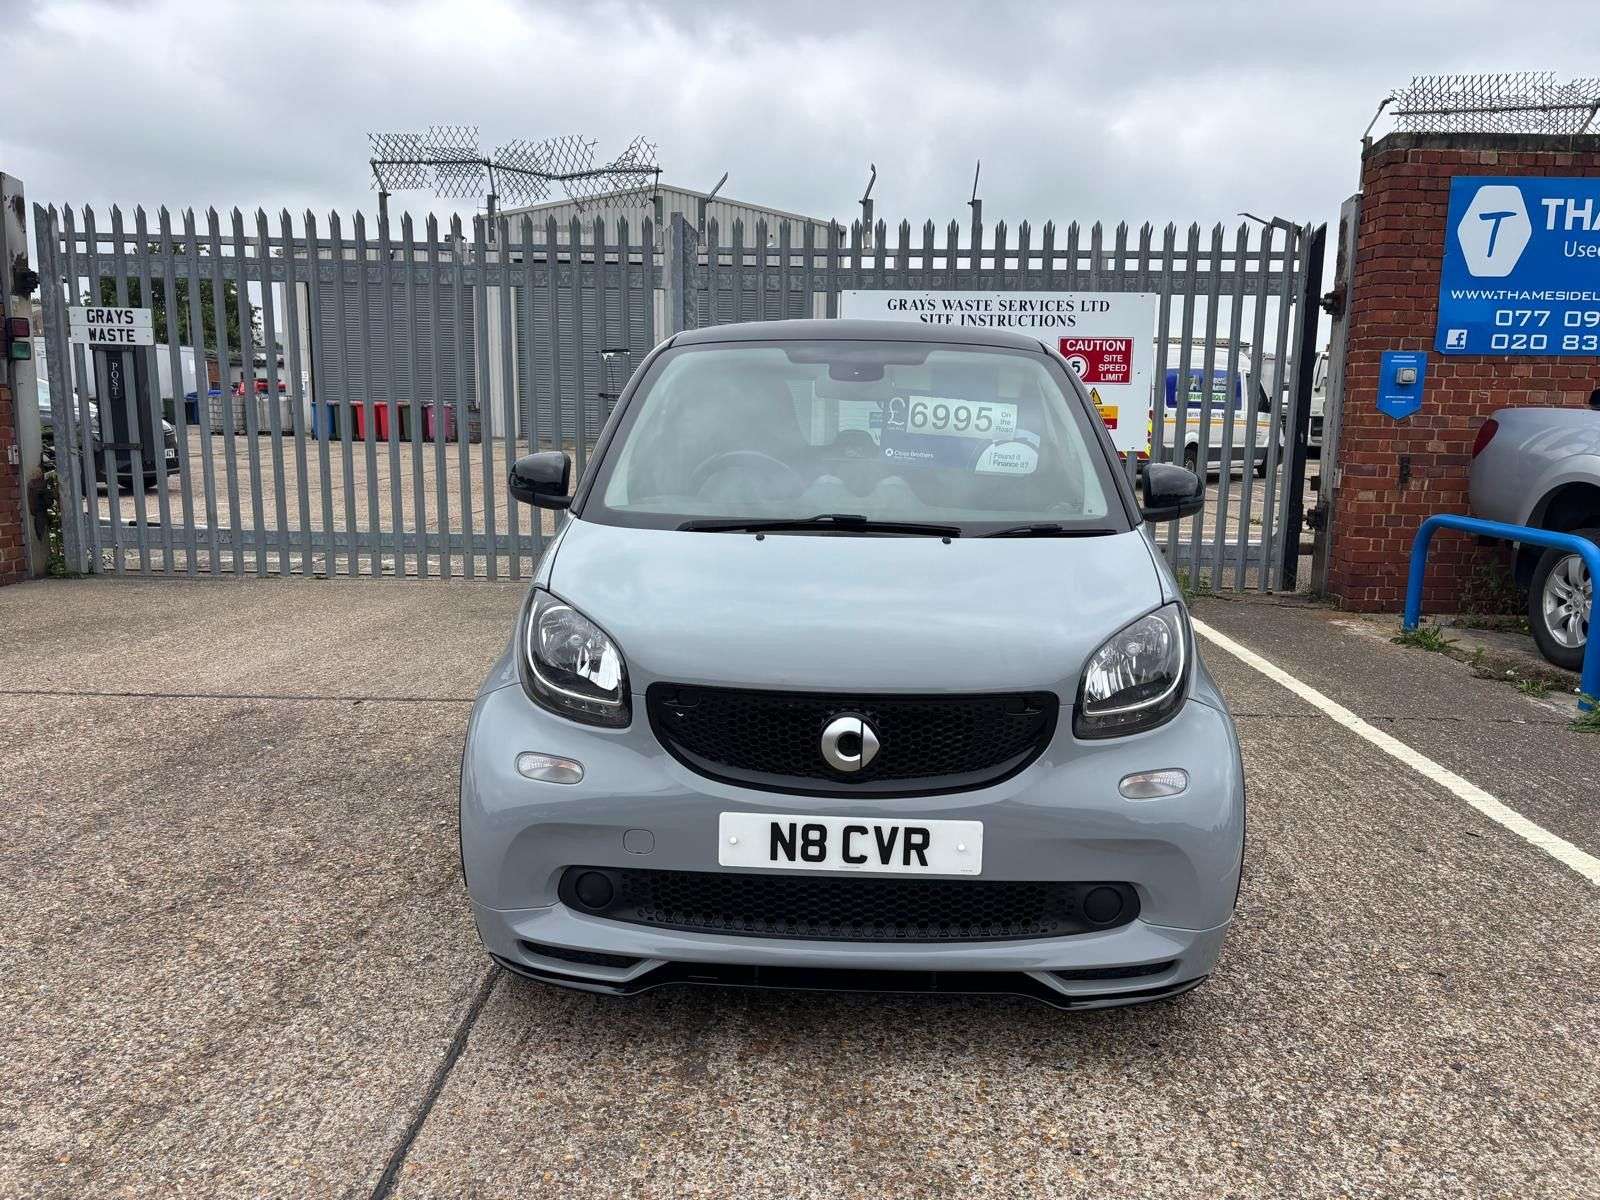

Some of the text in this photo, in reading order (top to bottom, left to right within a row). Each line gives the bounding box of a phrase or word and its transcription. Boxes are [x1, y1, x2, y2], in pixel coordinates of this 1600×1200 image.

[1564, 240, 1600, 258] Use
[887, 299, 1110, 312] GRAYS WASTE SERVICES LTD
[86, 308, 134, 324] GRAYS
[920, 313, 1077, 327] SITE INSTRUCTIONS
[1495, 309, 1600, 328] 077 09
[88, 327, 136, 342] WASTE
[1491, 333, 1598, 351] 020 83
[1066, 339, 1126, 352] CAUTION
[1103, 354, 1123, 363] SITE
[1098, 363, 1128, 372] SPEED
[111, 362, 120, 396] POST
[1100, 373, 1124, 381] LIMIT
[770, 821, 931, 866] N8 CVR
